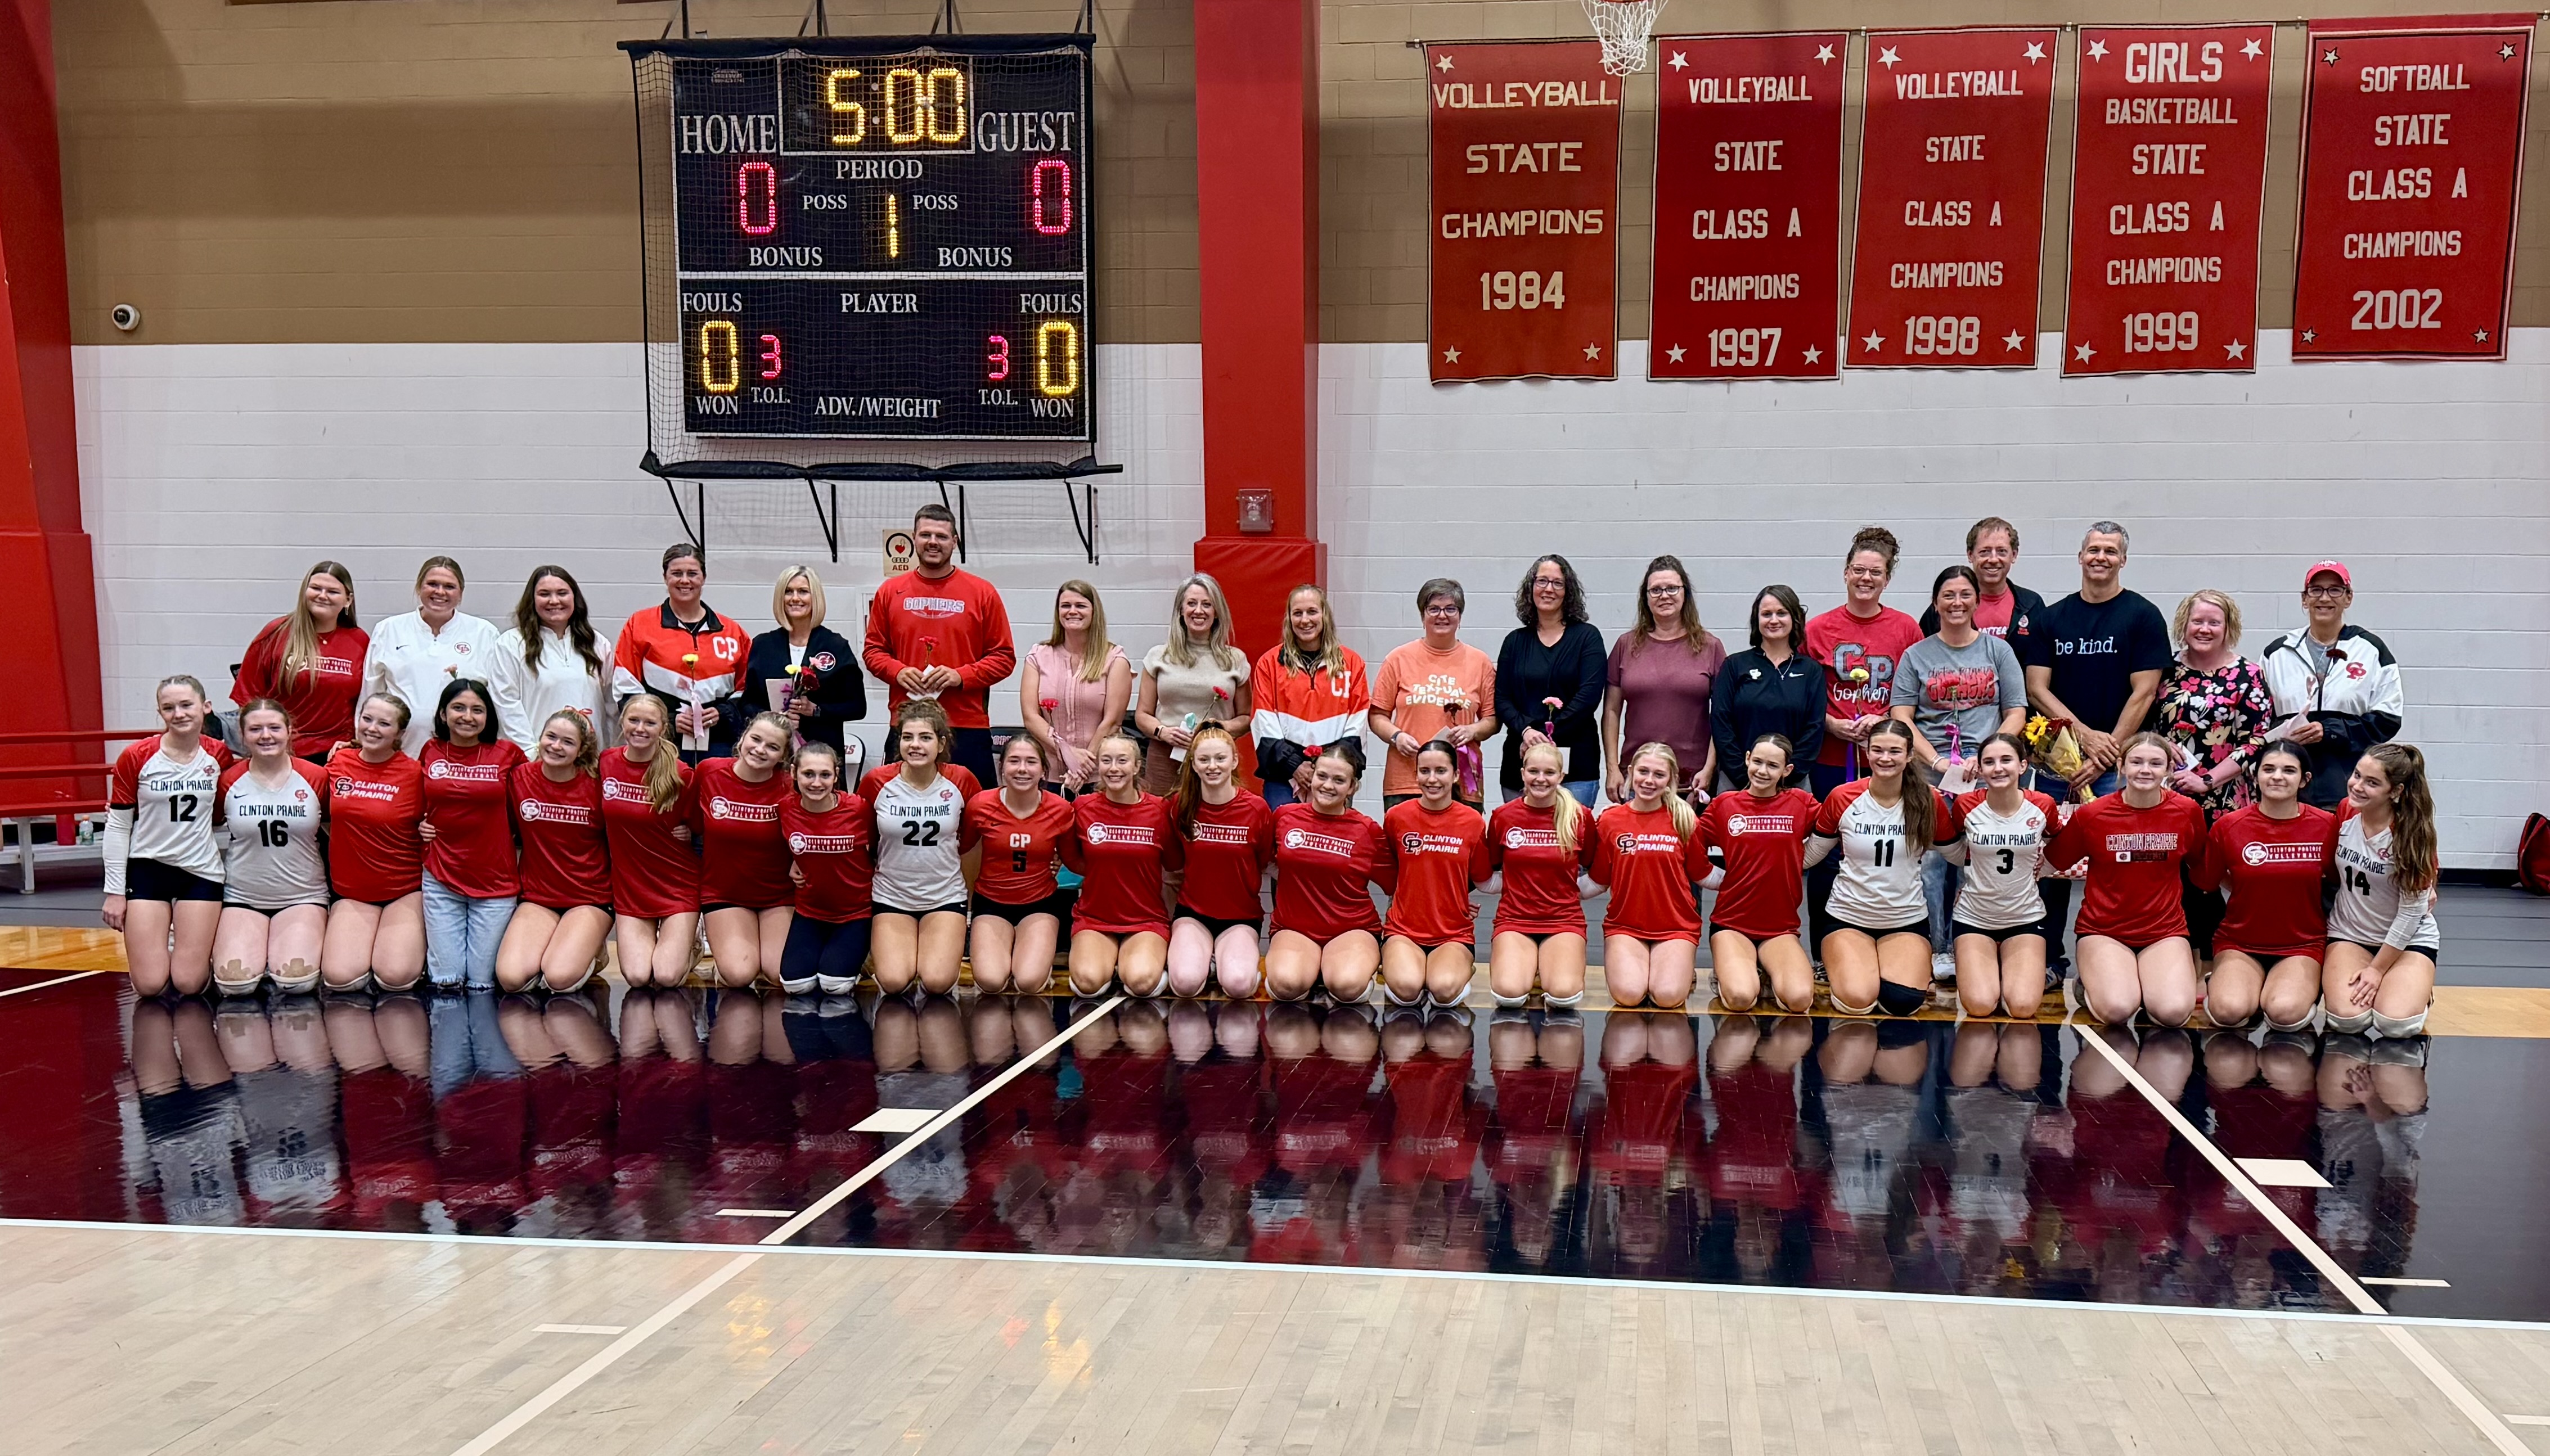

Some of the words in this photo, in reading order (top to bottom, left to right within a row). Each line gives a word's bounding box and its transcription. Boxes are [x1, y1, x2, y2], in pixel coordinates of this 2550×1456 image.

[2124, 42, 2224, 84] GIRLS
[1689, 76, 1813, 104] VOLLEYBALL
[1895, 70, 2023, 100] VOLLEYBALL
[2360, 64, 2470, 93] SOFTBALL
[829, 68, 967, 145] 5:00
[1433, 80, 1618, 109] VOLLEYBALL
[2105, 98, 2238, 125] BASKETBALL
[681, 115, 775, 153] HOME
[978, 112, 1074, 151] GUEST
[2374, 114, 2451, 146] STATE
[1467, 142, 1582, 174] STATE
[1715, 140, 1783, 172] STATE
[1926, 135, 1985, 163] STATE
[2132, 143, 2206, 175] STATE
[836, 160, 923, 179] PERIOD
[739, 161, 776, 234] 0
[1033, 160, 1070, 235] 0
[2347, 168, 2431, 201] CLASS
[2451, 168, 2468, 199] A
[803, 195, 847, 210] POSS
[913, 195, 958, 210] POSS
[1904, 201, 1972, 227] CLASS
[1989, 201, 2002, 226] A
[1442, 209, 1603, 238] CHAMPIONS
[1692, 209, 1768, 240] CLASS
[1787, 208, 1801, 237] A
[2110, 201, 2189, 236] CLASS
[2210, 201, 2224, 231] A
[749, 247, 822, 266] BONUS
[938, 247, 1012, 266] BONUS
[2344, 231, 2462, 259] CHAMPIONS
[1890, 261, 2003, 289] CHAMPIONS
[2106, 257, 2221, 286] CHAMPIONS
[1480, 271, 1565, 310] 1984
[1690, 274, 1800, 302] CHAMPIONS
[682, 292, 742, 312] FOULS
[840, 294, 918, 313] PLAYER
[1020, 294, 1081, 313] FOULS
[2351, 289, 2443, 331] 2002
[1905, 316, 1980, 355] 1998
[2122, 311, 2199, 354] 1999
[701, 320, 739, 392] 0
[761, 335, 781, 378] 3
[989, 335, 1009, 380] 3
[1039, 321, 1077, 394] 0
[1708, 327, 1782, 367] 1997
[695, 396, 739, 414] WON
[751, 387, 790, 404] T.O.L.
[815, 396, 941, 418] ADV./WEIGHT
[979, 389, 1018, 405] T.O.L.
[1031, 399, 1074, 418] WON
[903, 597, 965, 612] GOPHERS
[713, 636, 738, 661] CP
[2055, 639, 2073, 655] be
[2079, 637, 2117, 655] kind.
[1413, 684, 1465, 697] TEXTUAL
[1429, 674, 1455, 686] CITE
[151, 780, 183, 791] CLINTON
[187, 780, 213, 791] PRAIRIE
[352, 790, 393, 801] PRAIRIE
[355, 781, 399, 794] CLINTON
[169, 794, 198, 822] 12
[240, 805, 273, 816] CLINTON
[277, 805, 307, 817] PRAIRIE
[890, 805, 921, 817] CLINTON
[924, 804, 951, 816] PRAIRIE
[258, 820, 288, 847] 16
[902, 821, 940, 846] 22
[1010, 833, 1031, 848] CP
[1423, 835, 1463, 845] CLINTON
[1637, 833, 1678, 844] CLINTON
[1855, 823, 1885, 836] CLINTON
[1888, 824, 1906, 836] PRAI
[1972, 832, 2006, 845] CLINTON
[2009, 832, 2038, 845] PRAIRIE
[2106, 833, 2144, 851] CLINTON
[1012, 850, 1027, 873] 5
[1422, 844, 1460, 854] PRAIRIE
[1637, 843, 1675, 853] PRAIRIE
[1874, 839, 1894, 867] 11
[1996, 849, 2014, 874] 3
[2337, 844, 2360, 864] CLINTON
[2360, 855, 2385, 874] PRAIRIE
[2345, 866, 2371, 896] 14
